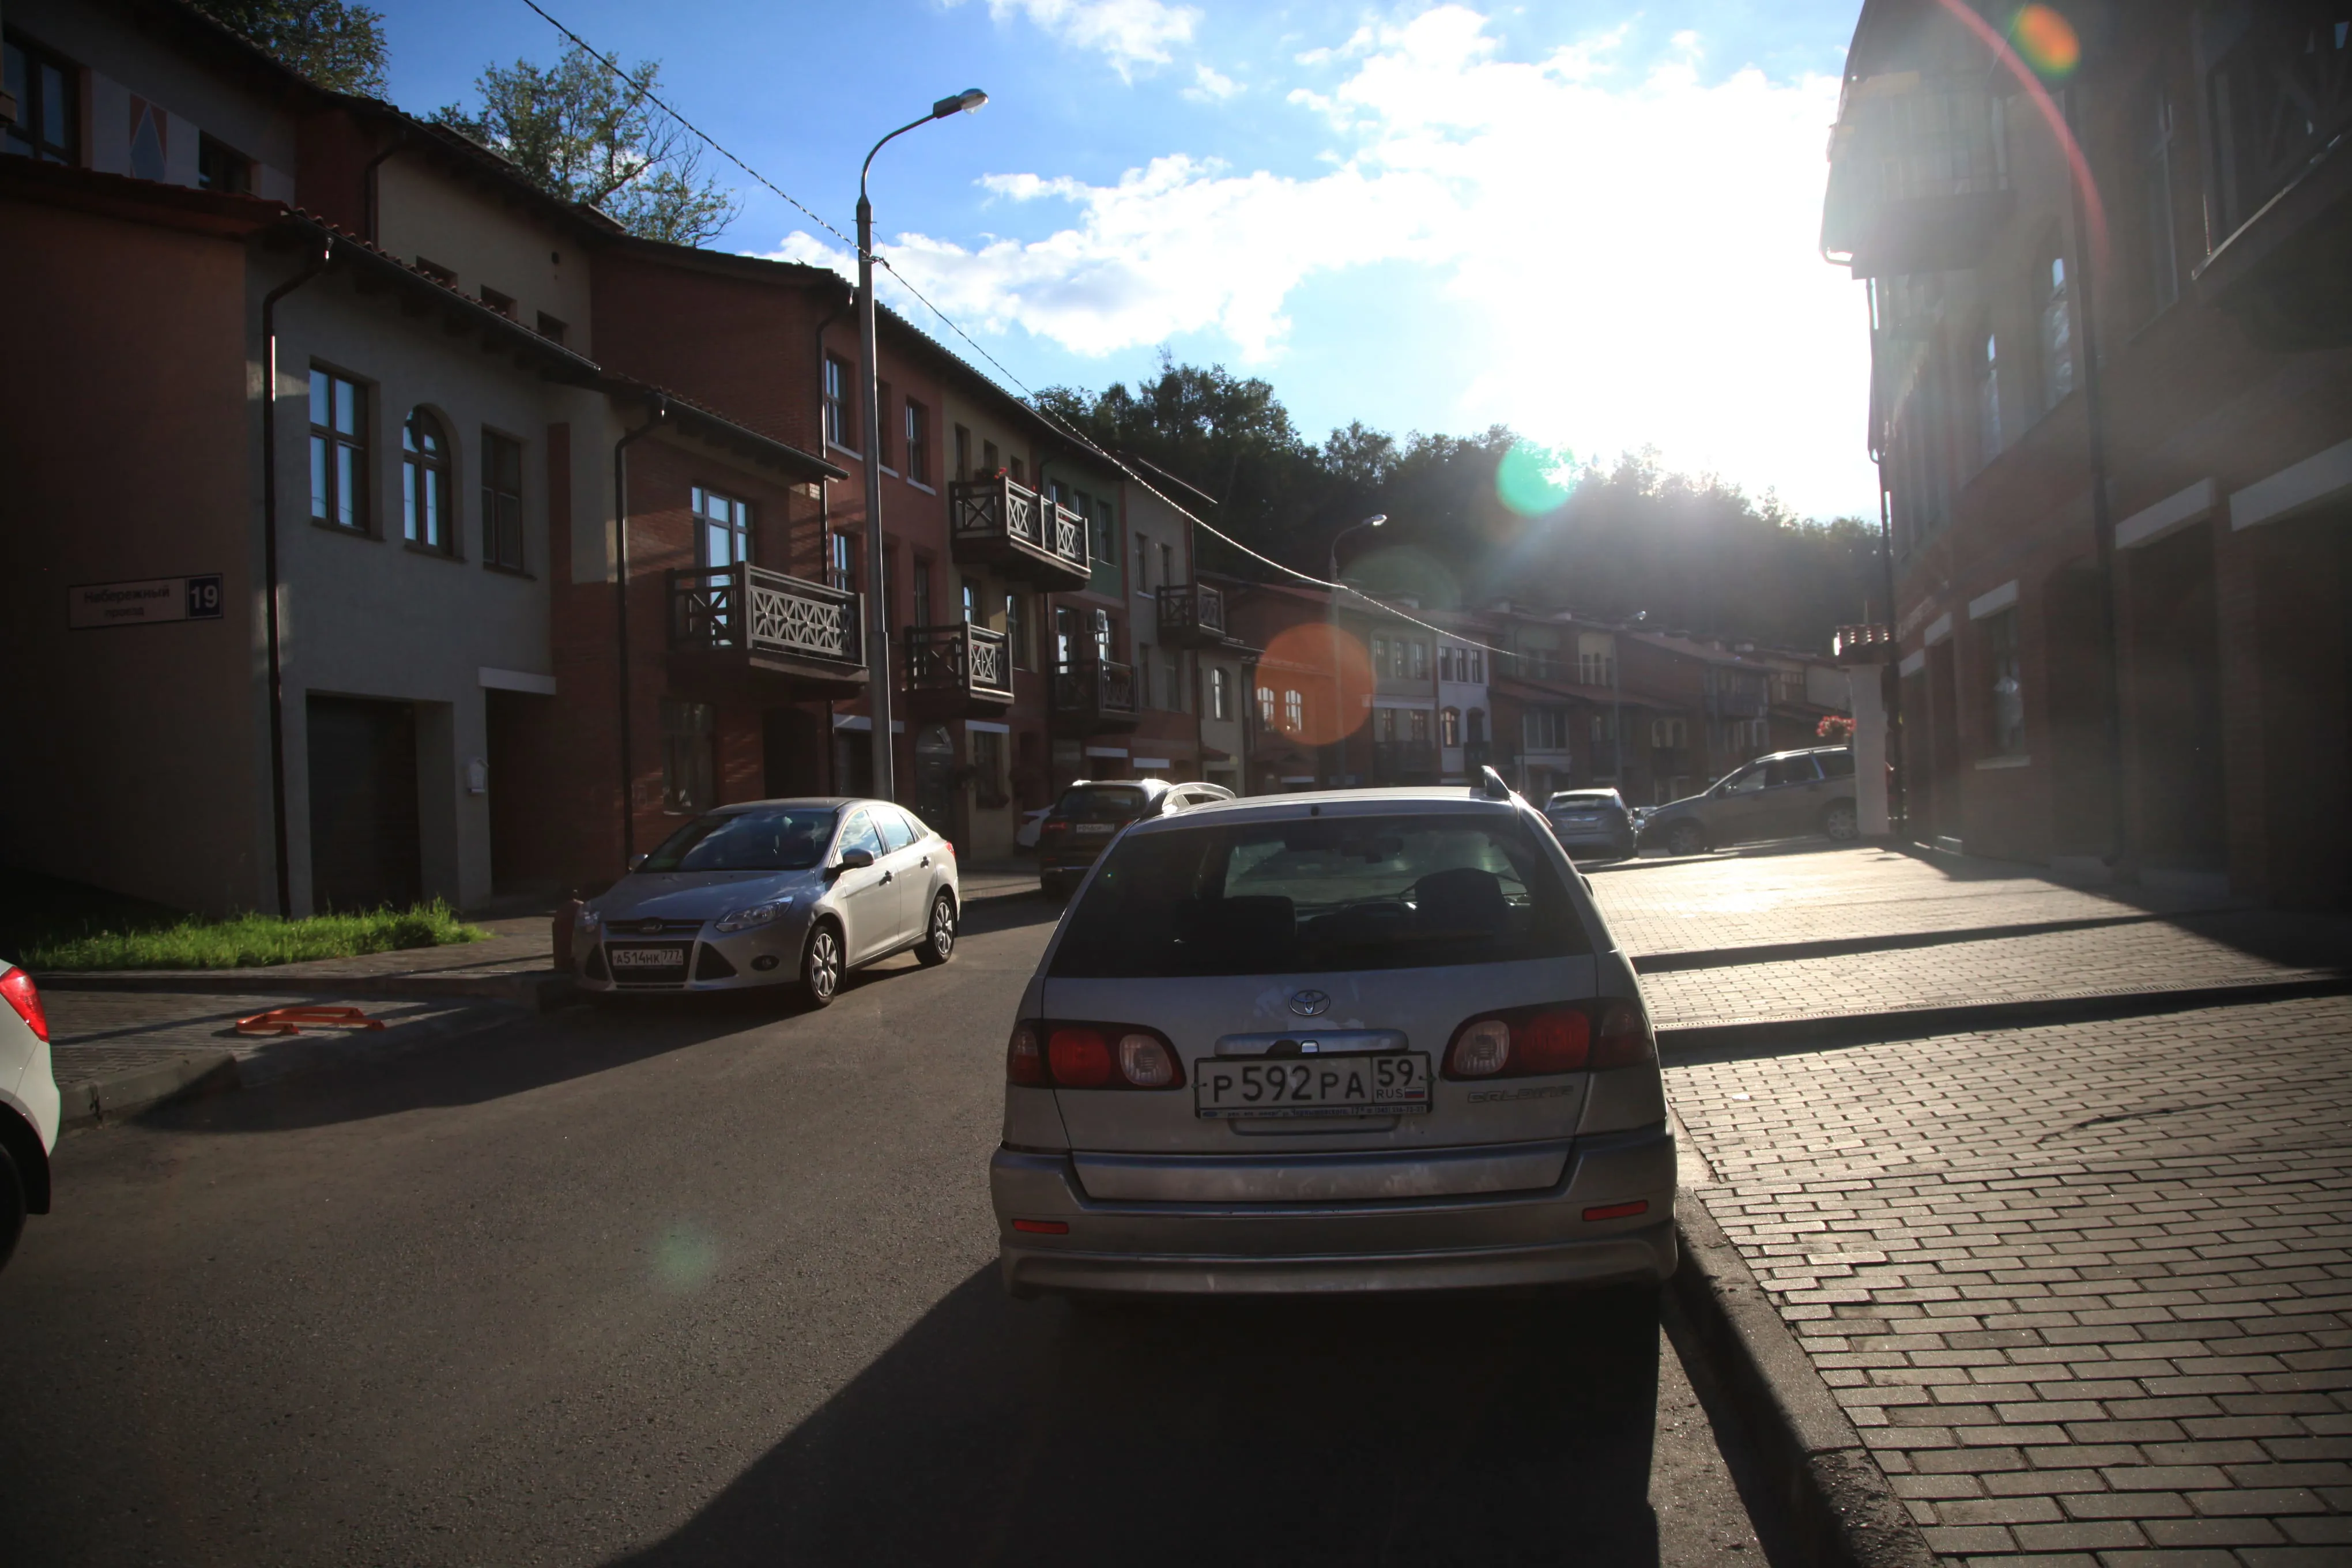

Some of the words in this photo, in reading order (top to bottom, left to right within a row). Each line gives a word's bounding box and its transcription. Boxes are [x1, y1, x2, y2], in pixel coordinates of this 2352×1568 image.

[190, 585, 218, 609] 19
[1213, 1065, 1366, 1103] Р592РА
[1377, 1058, 1414, 1087] 59
[1376, 1088, 1404, 1099] RUS
